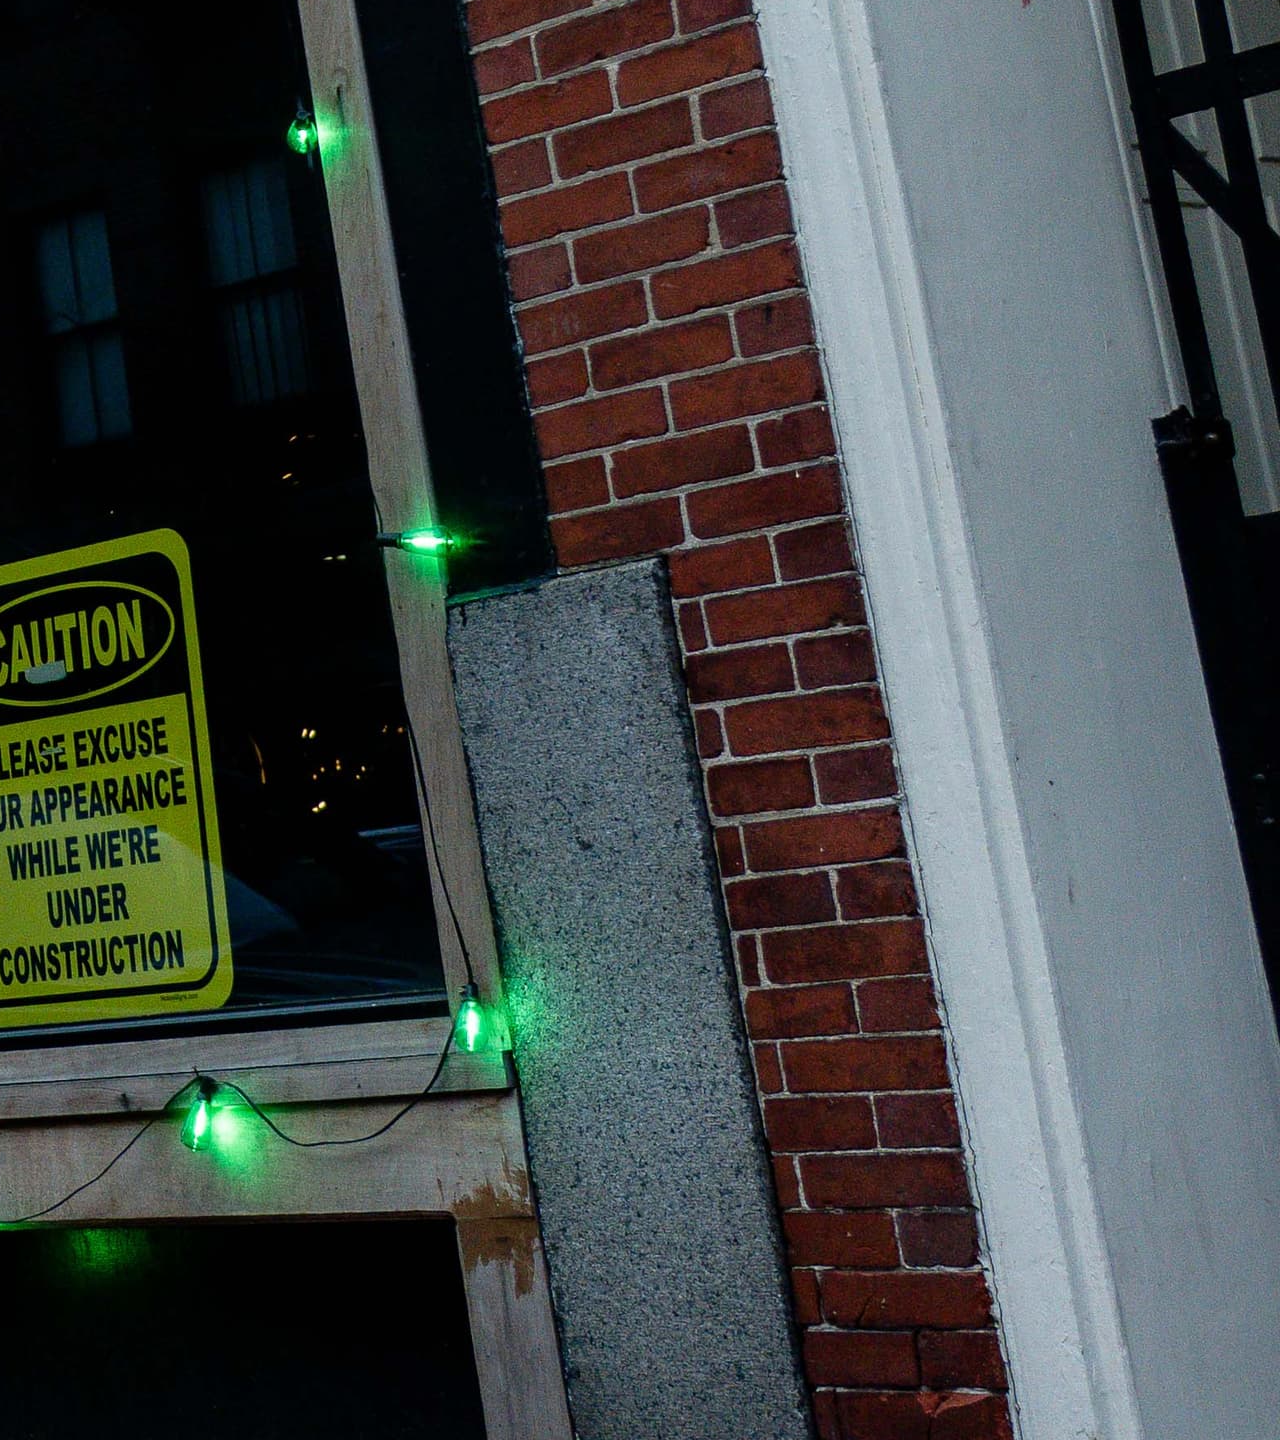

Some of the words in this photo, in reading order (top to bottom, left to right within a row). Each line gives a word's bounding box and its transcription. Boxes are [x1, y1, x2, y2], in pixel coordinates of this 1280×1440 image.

[75, 717, 168, 767] EXCUSE
[30, 767, 188, 828] APPEARANCE
[7, 836, 81, 881] WHILE
[85, 825, 161, 871] WE'RE
[47, 883, 129, 928] UNDER
